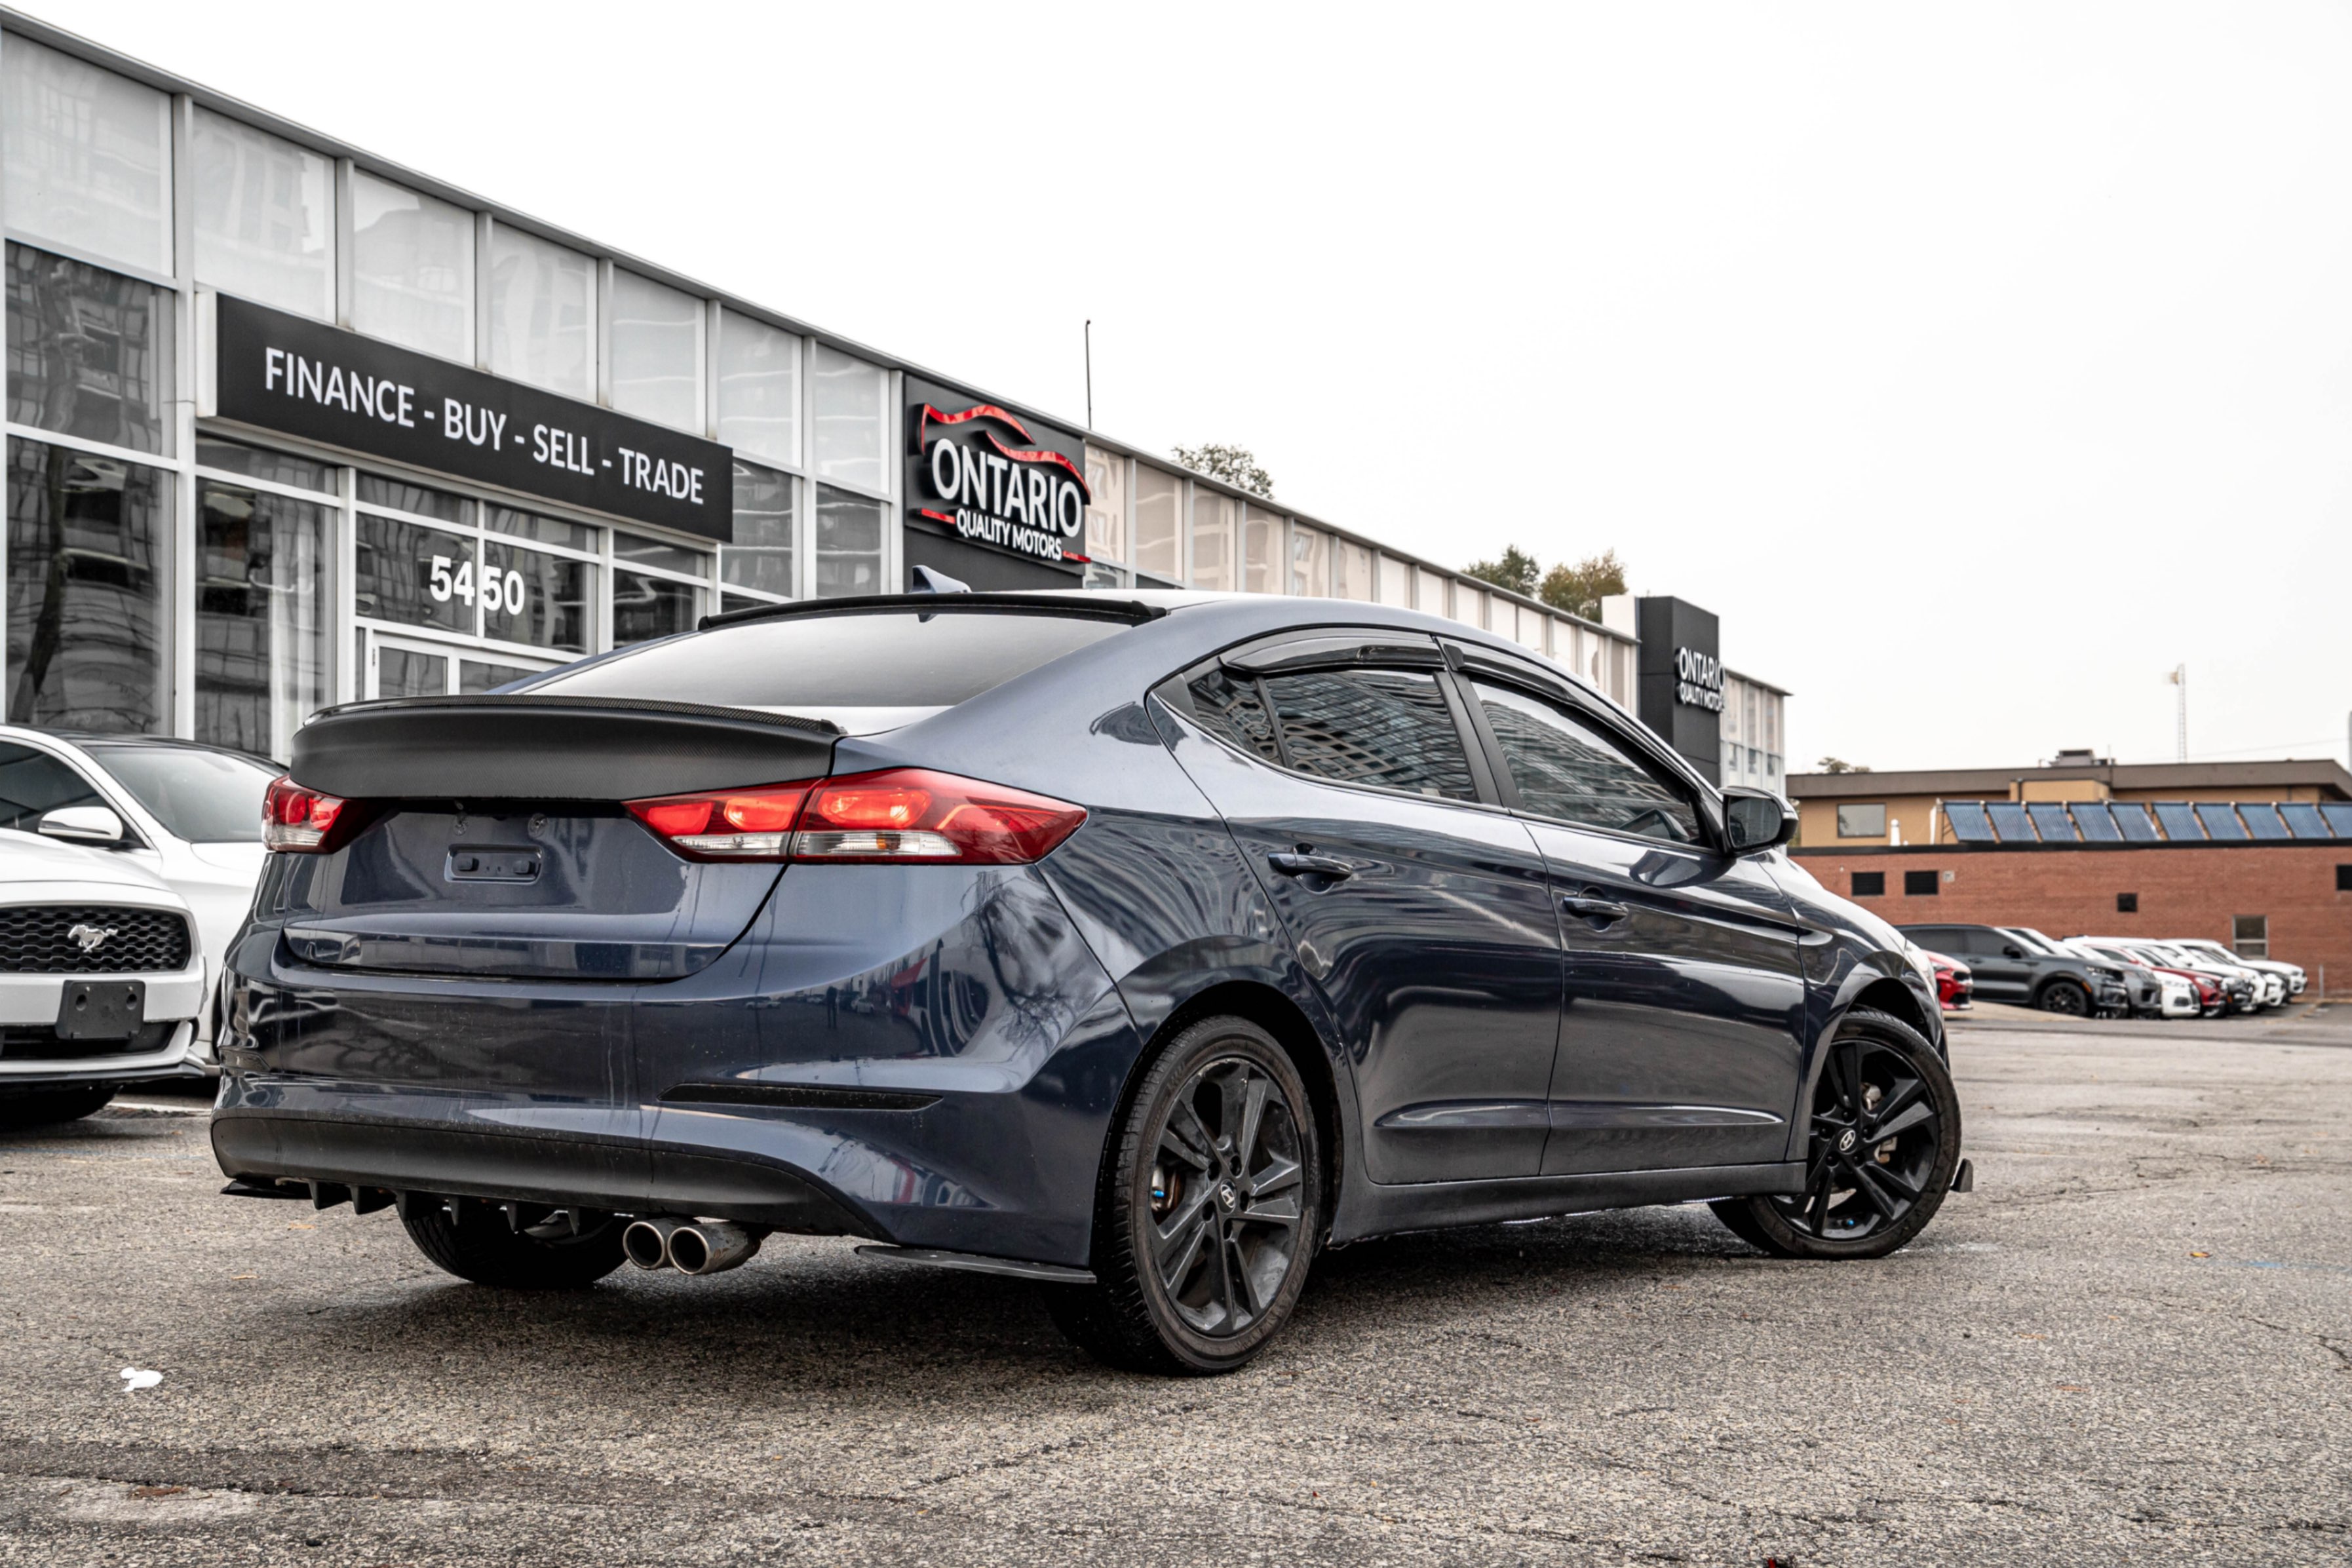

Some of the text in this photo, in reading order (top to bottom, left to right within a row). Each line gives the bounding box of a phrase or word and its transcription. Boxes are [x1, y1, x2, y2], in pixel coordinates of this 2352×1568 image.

[265, 347, 415, 428] FINANCE
[444, 397, 507, 451] BUY
[533, 424, 594, 475] SELL
[618, 448, 704, 505] TRADE
[932, 438, 1082, 537] ONTARIO
[956, 508, 1062, 561] QUALITY MOTORS
[429, 554, 525, 615] 5450
[1679, 647, 1725, 691] ONTARIO
[1680, 681, 1704, 706] QUALITY
